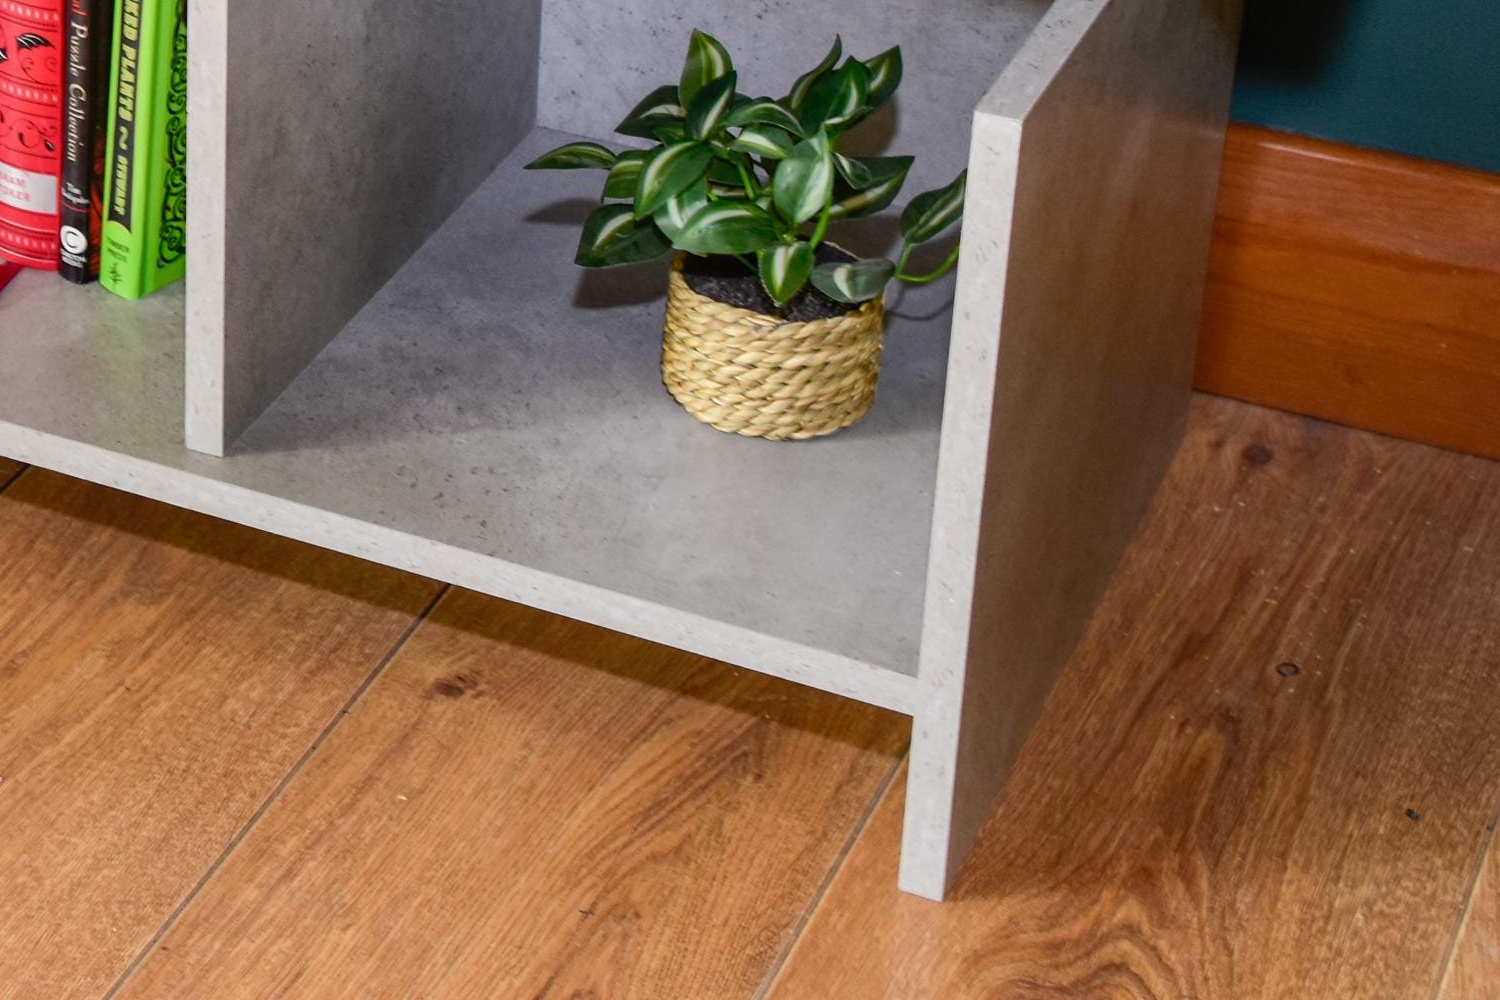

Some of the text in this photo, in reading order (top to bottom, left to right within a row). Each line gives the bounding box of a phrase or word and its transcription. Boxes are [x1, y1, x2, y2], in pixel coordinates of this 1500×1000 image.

[69, 21, 89, 77] Puzzle
[119, 43, 138, 121] PLANTS
[66, 84, 87, 162] Collection
[113, 155, 129, 216] STEWART
